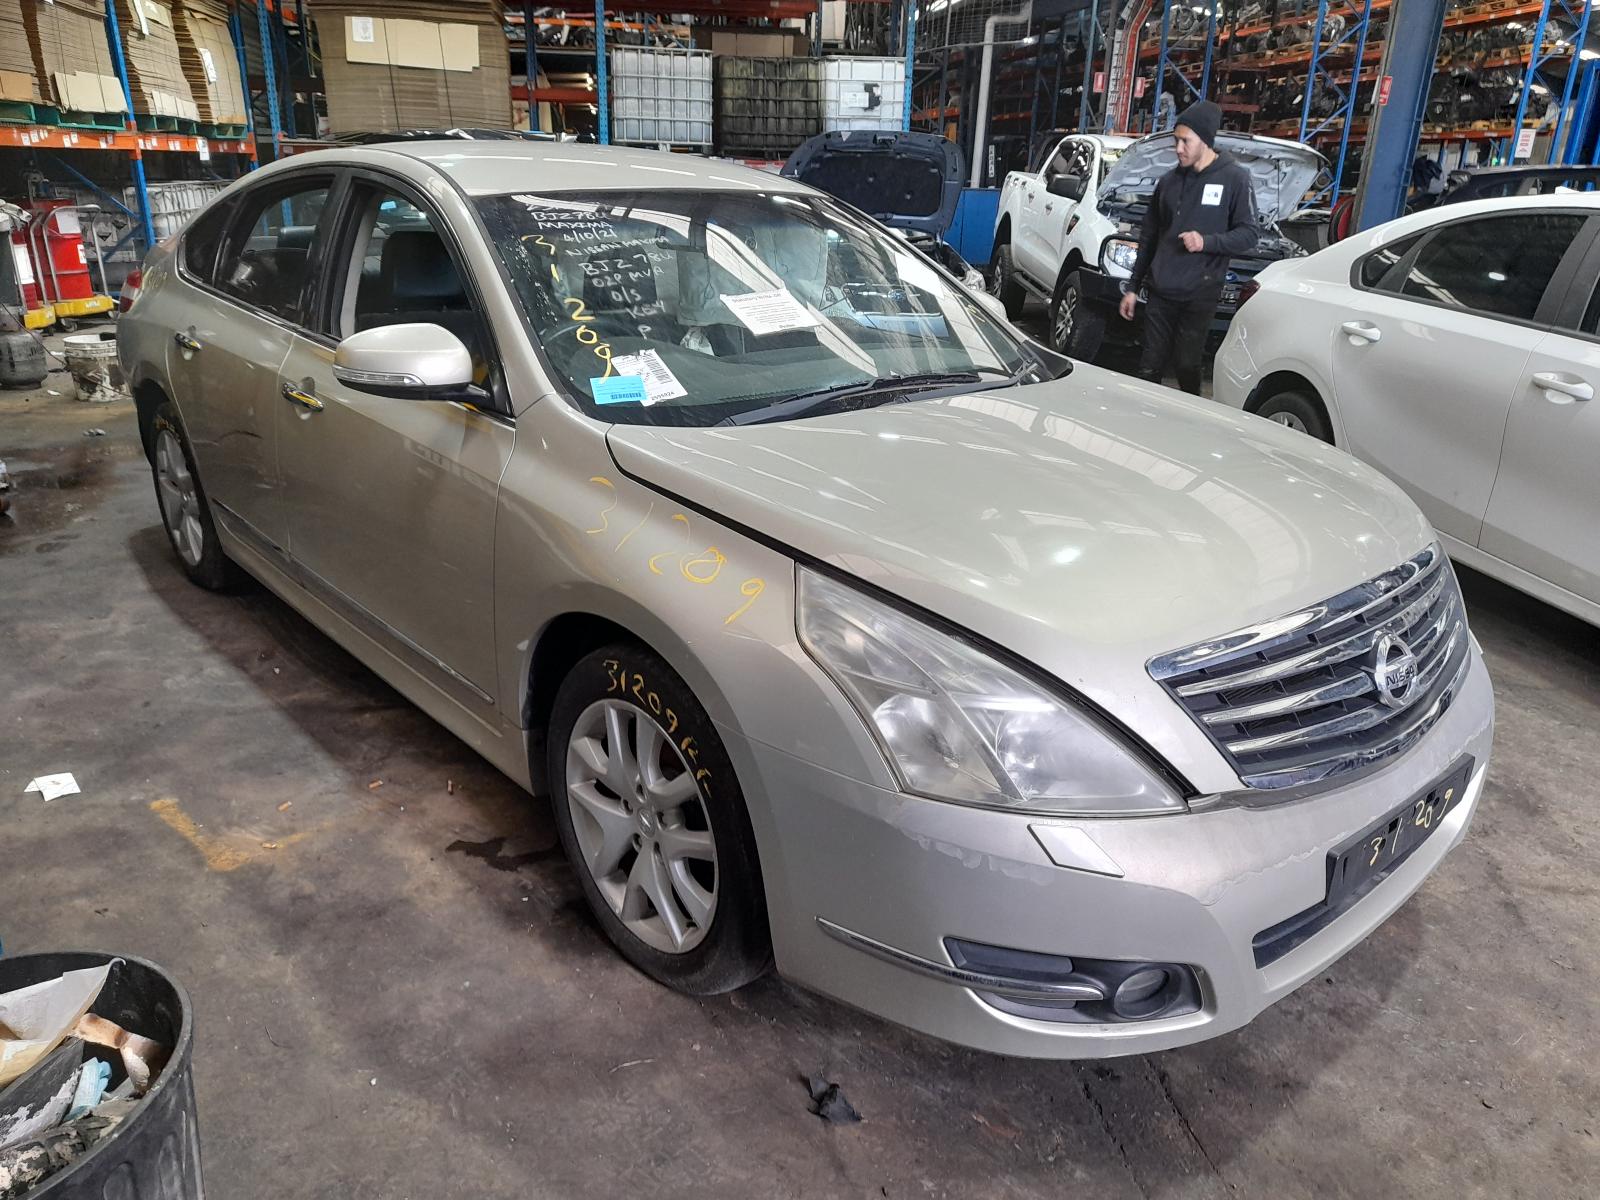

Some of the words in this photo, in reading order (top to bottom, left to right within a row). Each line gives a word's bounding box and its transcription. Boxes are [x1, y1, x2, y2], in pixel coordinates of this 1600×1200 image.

[537, 221, 613, 230] MAXIMA
[562, 228, 618, 244] 4/10/21
[565, 242, 622, 257] NISSAN
[625, 300, 666, 319] KEY
